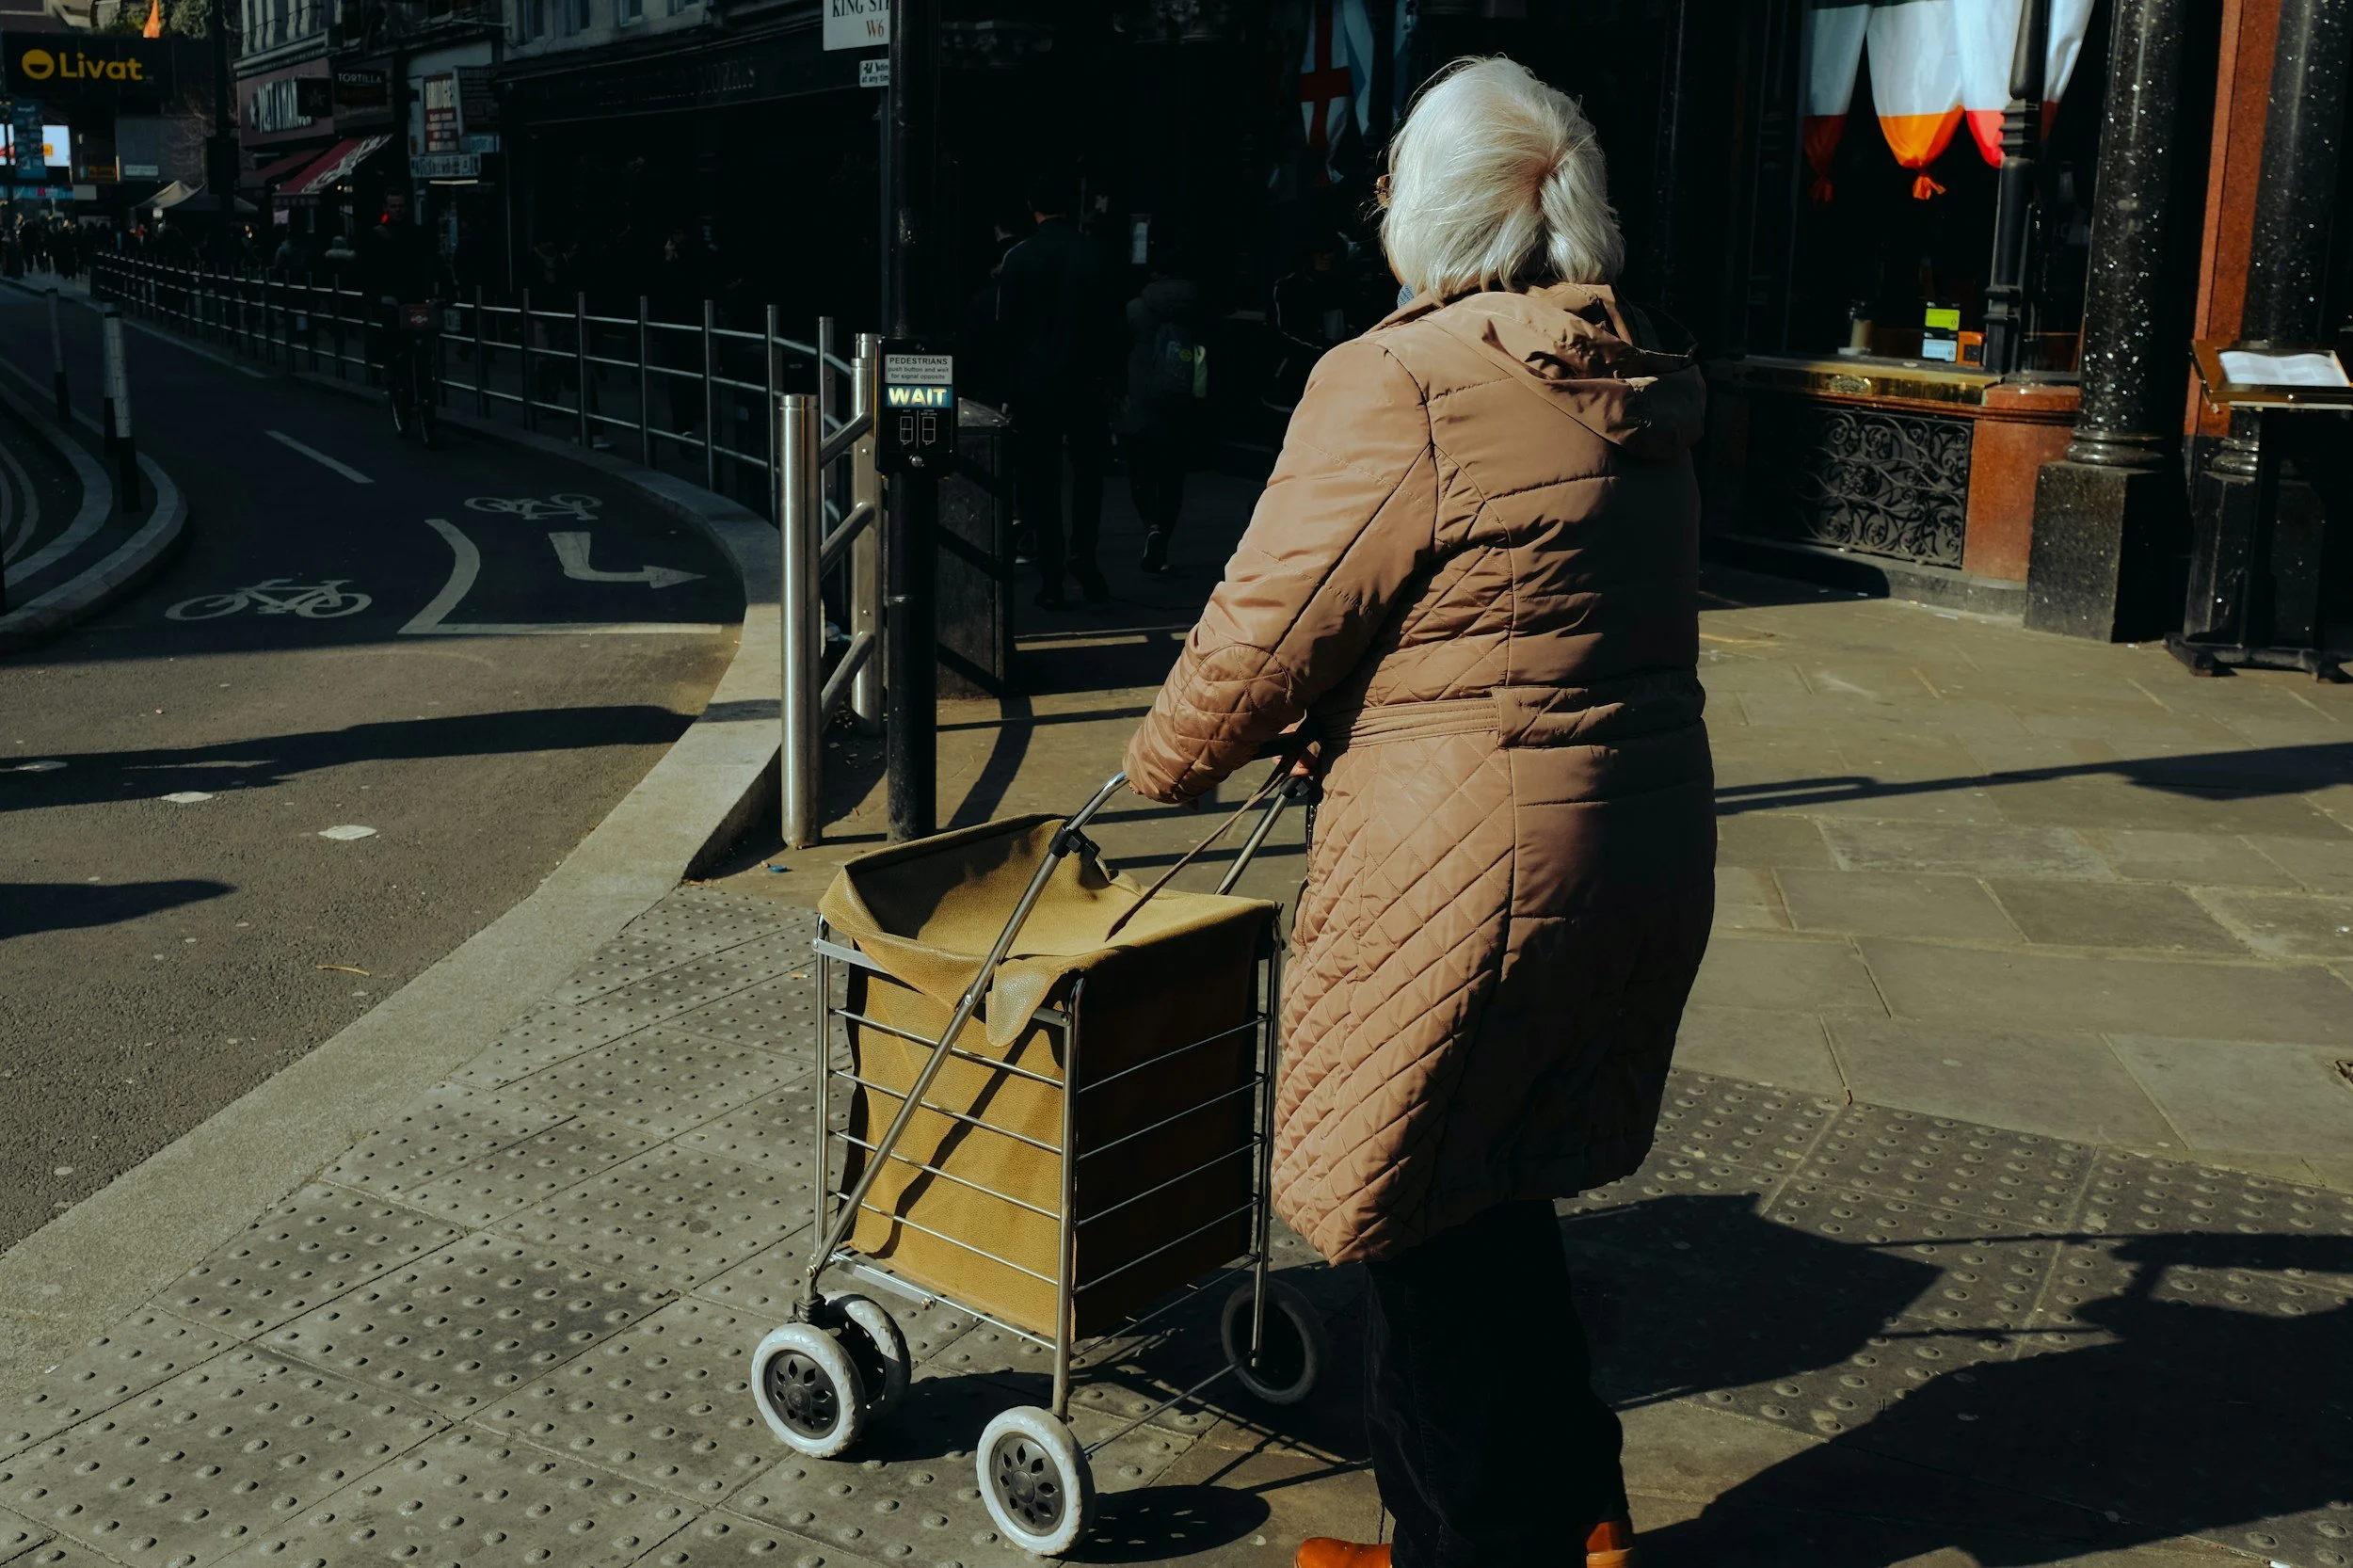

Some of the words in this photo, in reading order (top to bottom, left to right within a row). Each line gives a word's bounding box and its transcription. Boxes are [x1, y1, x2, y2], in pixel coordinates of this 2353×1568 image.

[832, 0, 863, 17] KING
[866, 18, 885, 38] W6
[59, 52, 143, 81] Livat
[338, 72, 382, 84] TORTILLA
[889, 357, 948, 365] PEDESTRIANS
[888, 387, 947, 406] WAIT
